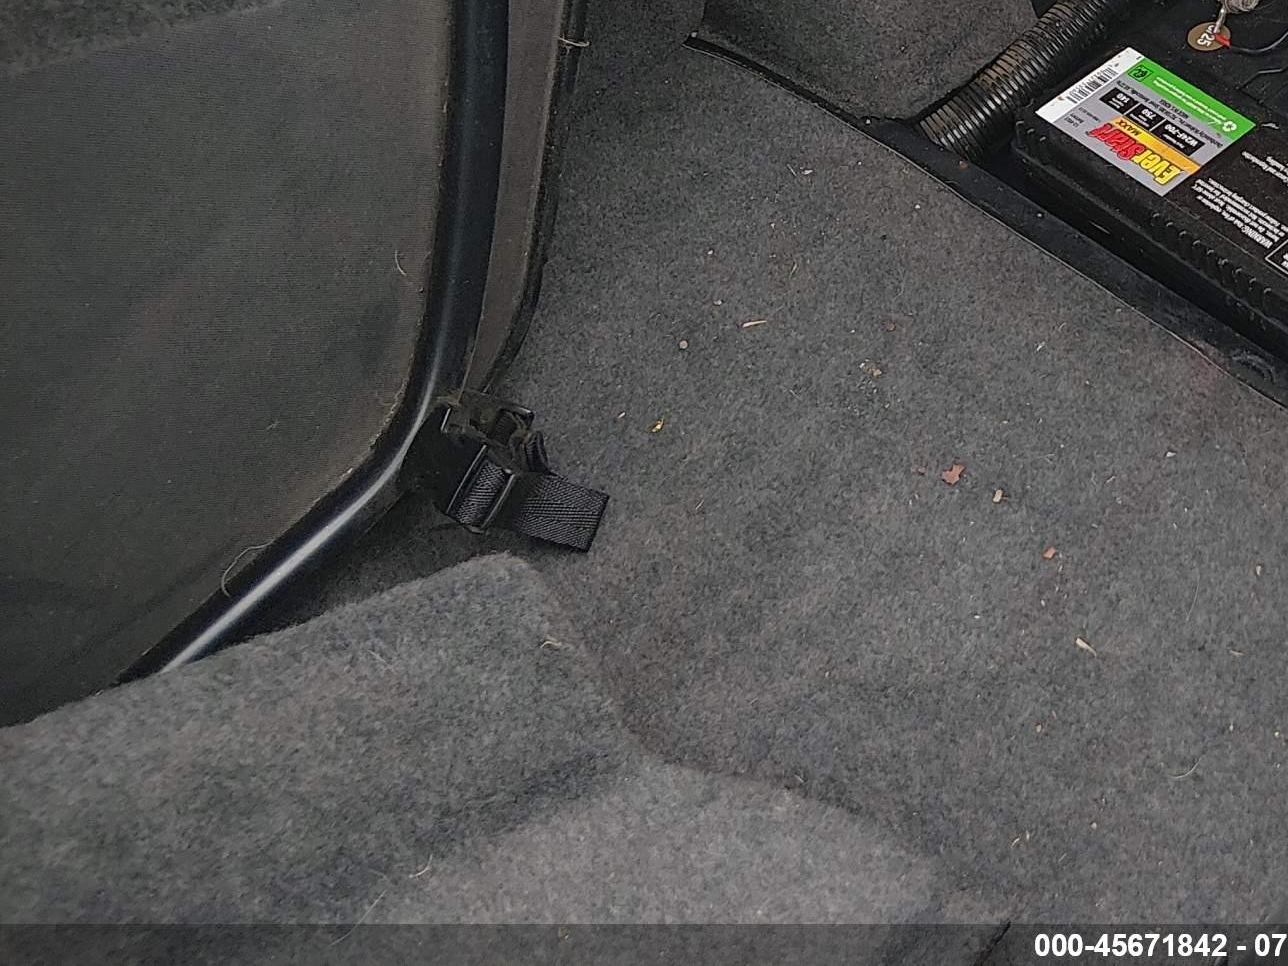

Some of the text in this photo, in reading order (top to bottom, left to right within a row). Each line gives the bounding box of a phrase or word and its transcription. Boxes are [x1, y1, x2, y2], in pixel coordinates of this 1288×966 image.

[1117, 93, 1130, 103] 140
[1142, 109, 1156, 119] 750
[1116, 120, 1141, 136] MAXX
[1165, 124, 1197, 146] W24F-700
[1087, 122, 1183, 186] EverStart
